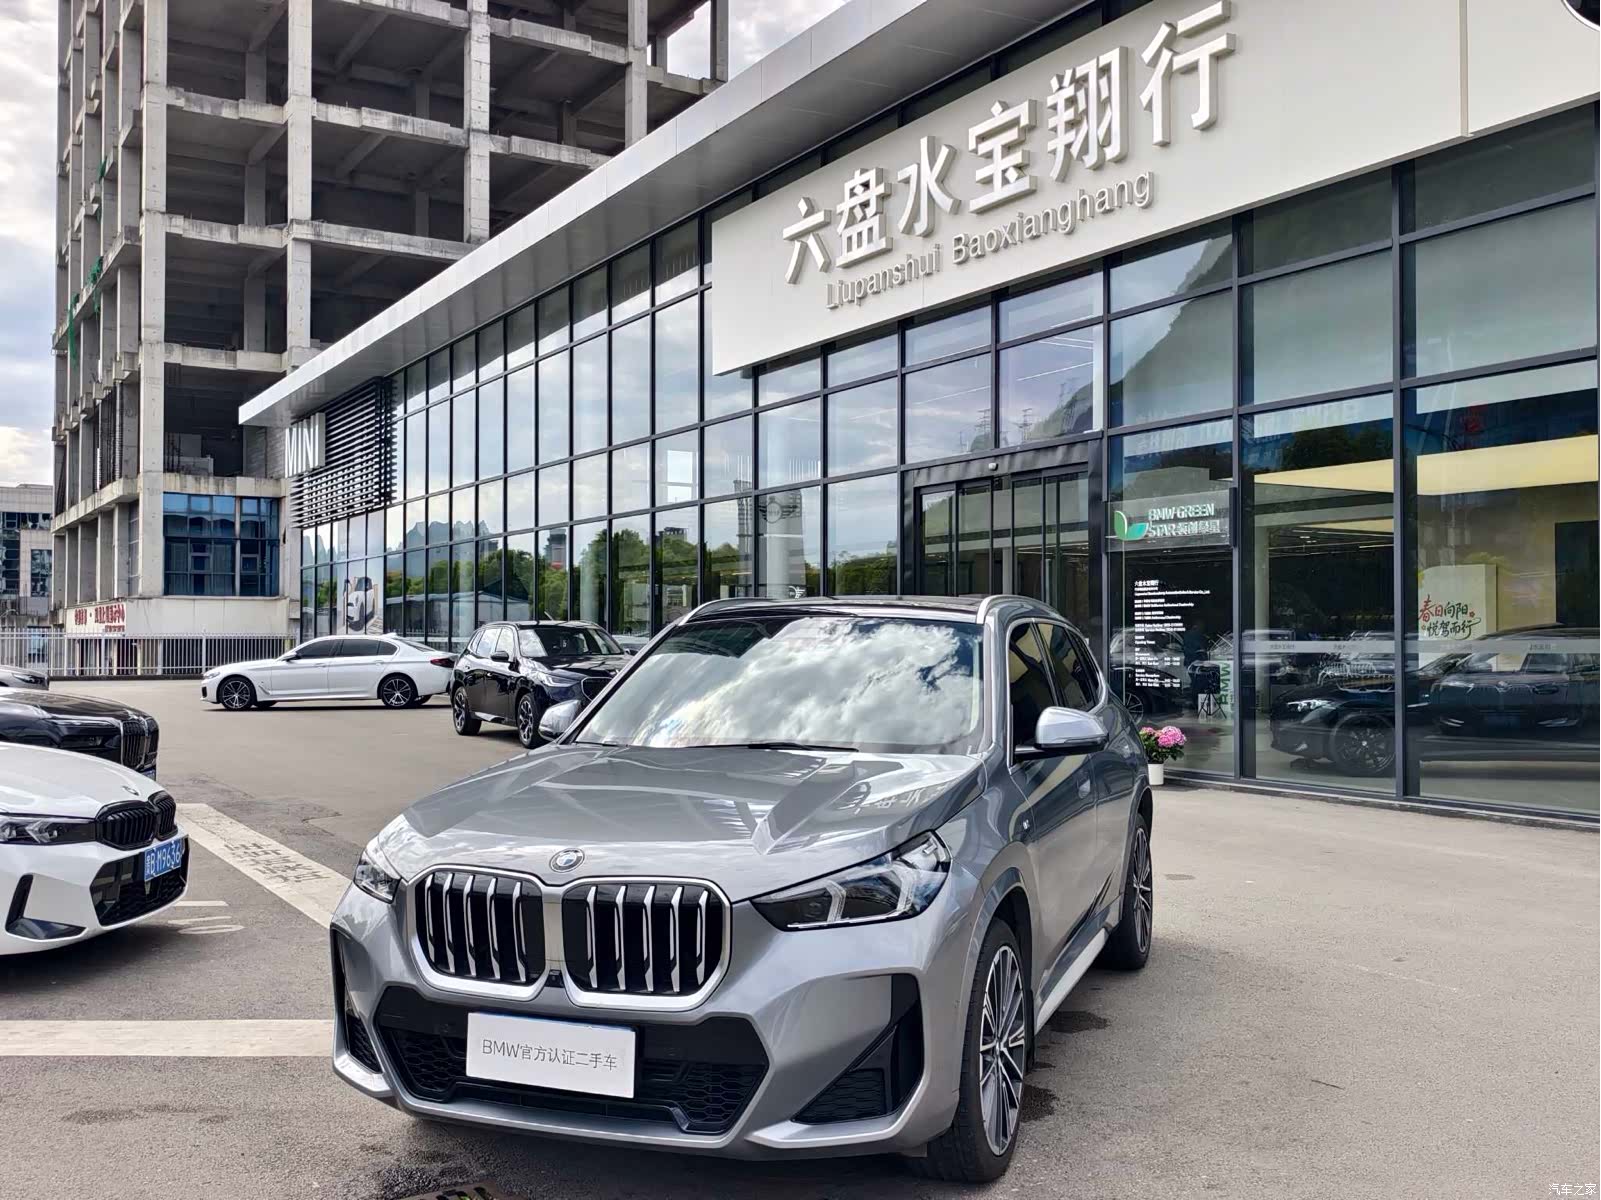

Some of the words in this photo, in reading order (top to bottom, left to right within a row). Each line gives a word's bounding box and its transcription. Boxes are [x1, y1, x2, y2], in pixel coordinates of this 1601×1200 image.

[782, 1, 1237, 284] 六盘水宝翔行
[825, 242, 941, 310] Liupanshui
[951, 170, 1155, 265] Baoxianghang
[284, 412, 326, 479] MINI
[1148, 507, 1175, 520] BMW
[1177, 503, 1215, 519] GREEN
[1149, 523, 1176, 537] STAR
[1418, 595, 1469, 623] 春日向阳
[1426, 617, 1482, 640] 悦驾而行
[482, 1039, 617, 1071] BMW官方认证二手车
